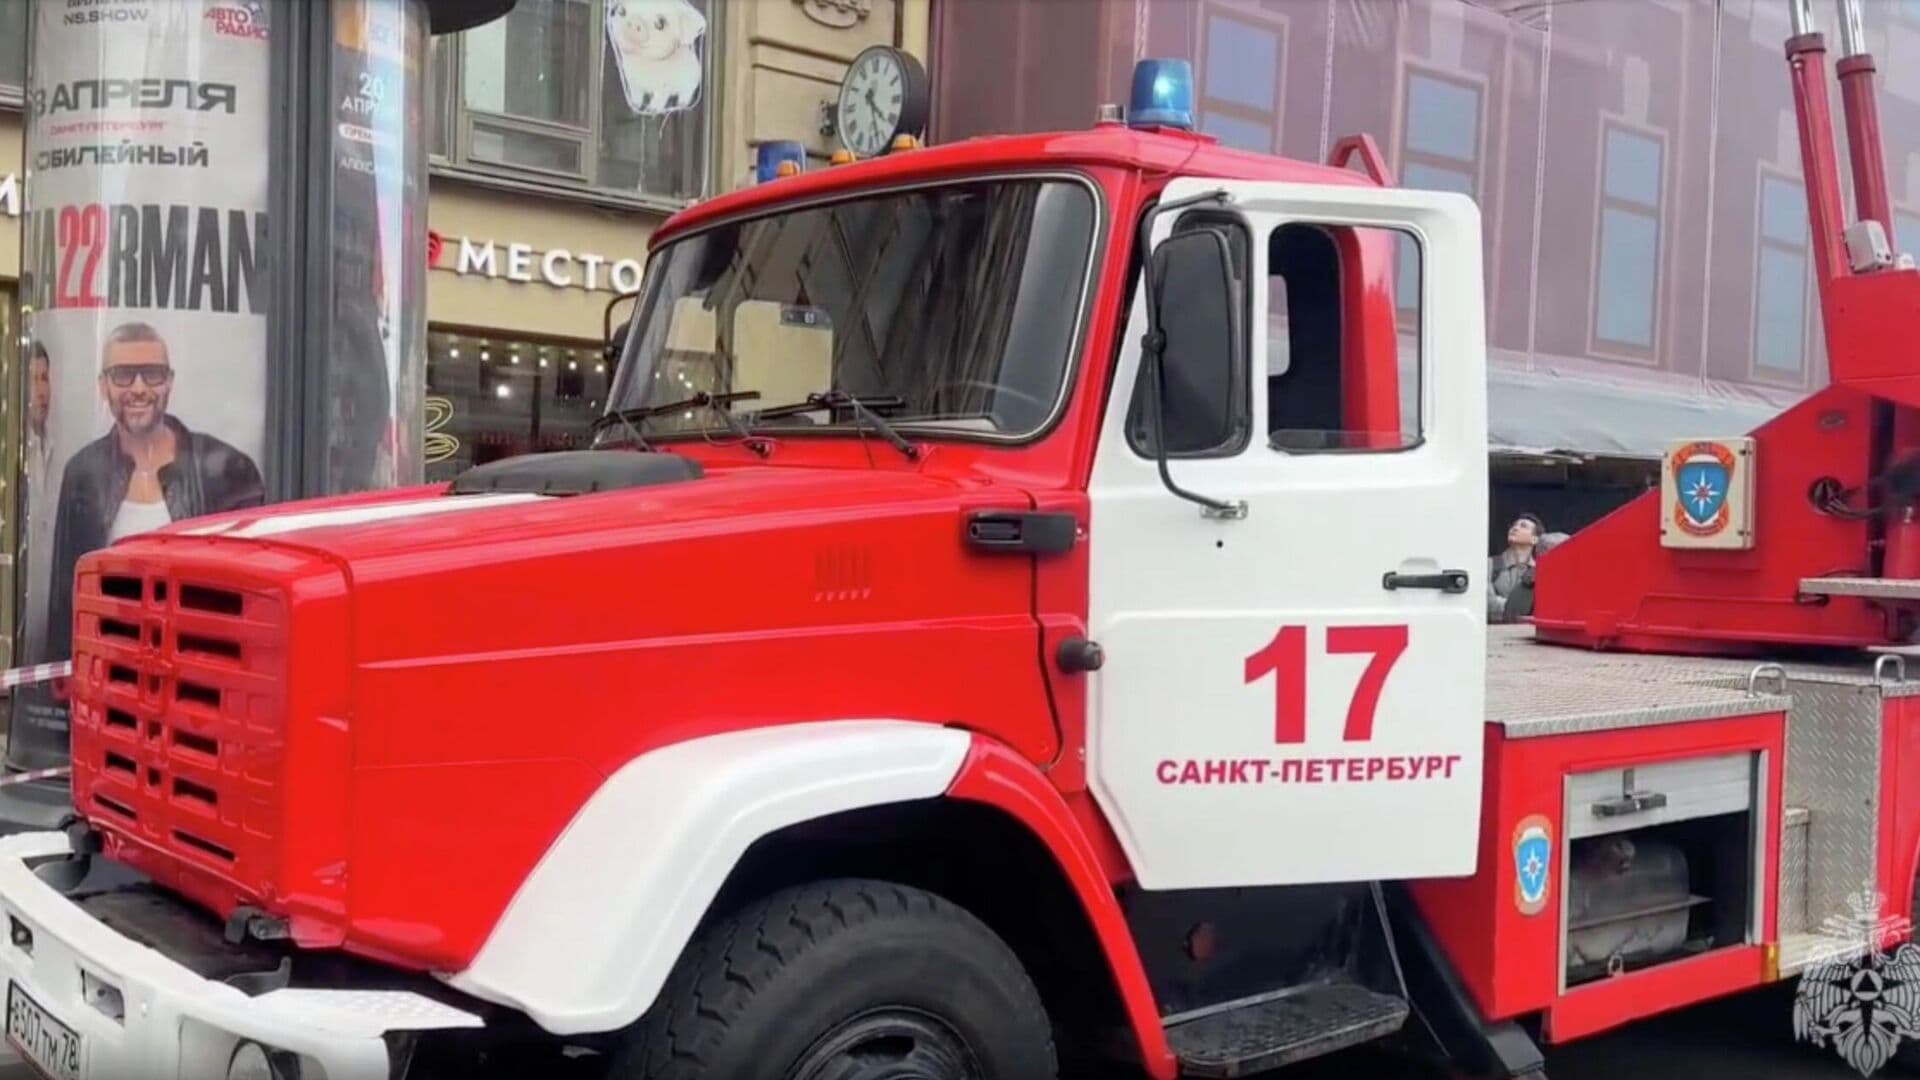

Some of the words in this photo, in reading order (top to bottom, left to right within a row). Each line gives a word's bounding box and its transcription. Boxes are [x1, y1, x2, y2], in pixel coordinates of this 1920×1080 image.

[203, 7, 249, 24] АВТО
[215, 22, 271, 40] РАДИО
[50, 78, 237, 115] АПРЕЛЯ
[456, 236, 643, 294] МЕСТО
[1244, 624, 1409, 744] 17
[1156, 755, 1462, 785] САНКТ-ПЕТЕРБУРГ
